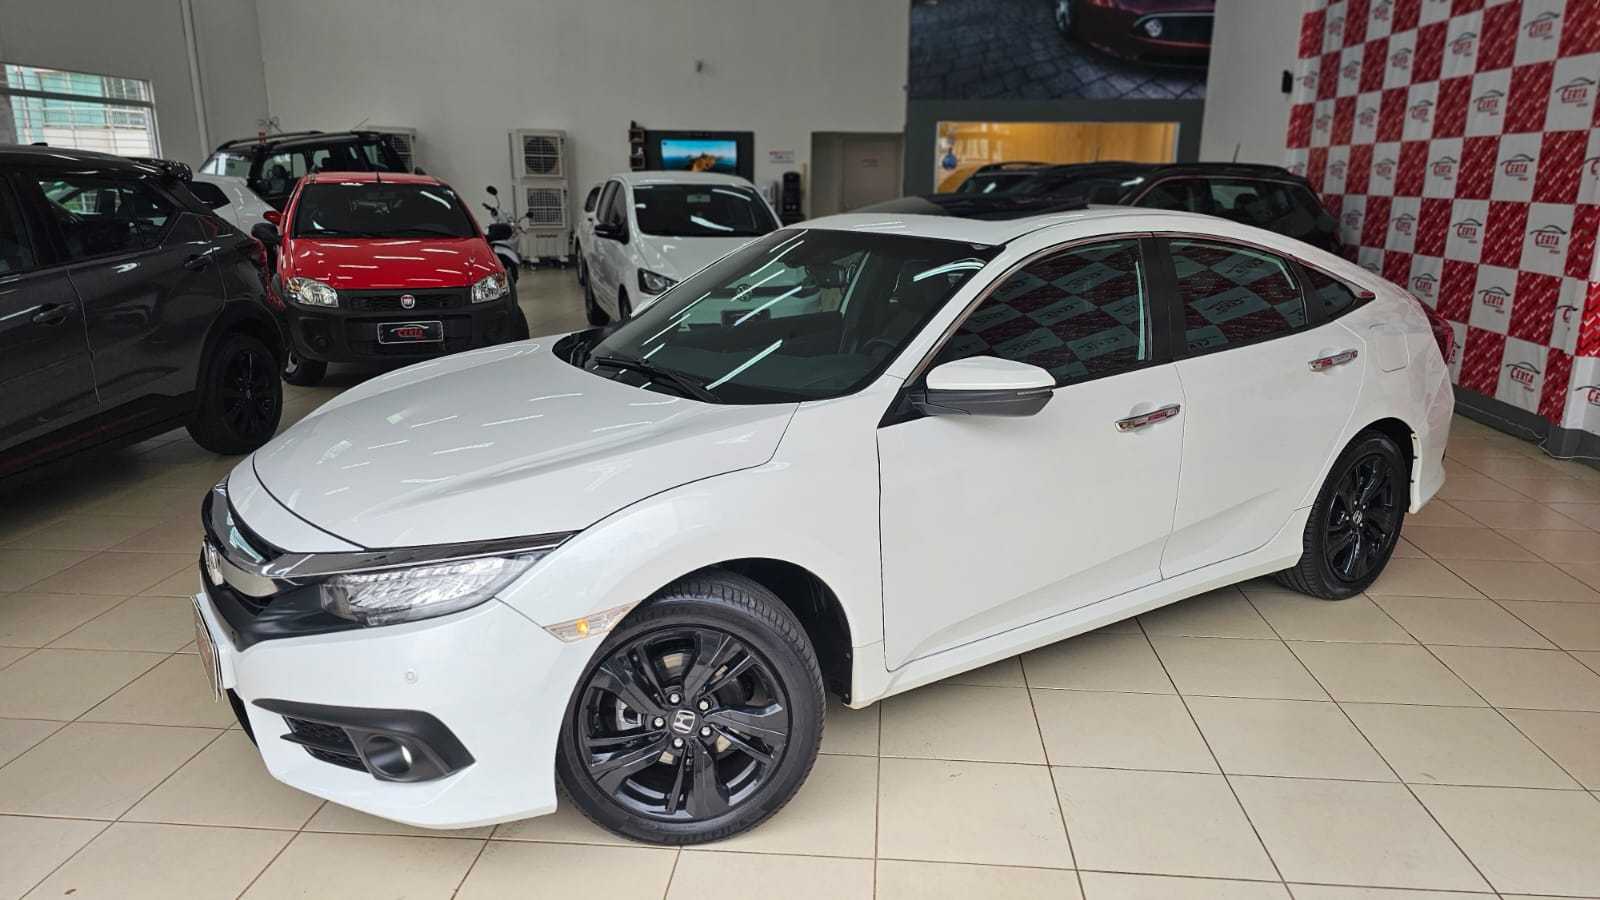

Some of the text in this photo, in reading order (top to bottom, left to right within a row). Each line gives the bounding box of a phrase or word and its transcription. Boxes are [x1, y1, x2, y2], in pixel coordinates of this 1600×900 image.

[1561, 87, 1587, 103] CERTA
[1505, 161, 1528, 175] CERTA
[1457, 224, 1477, 238] CERTA
[1535, 232, 1560, 247] CERTA
[1483, 292, 1504, 307] CERTA
[1510, 367, 1534, 383] CERTA
